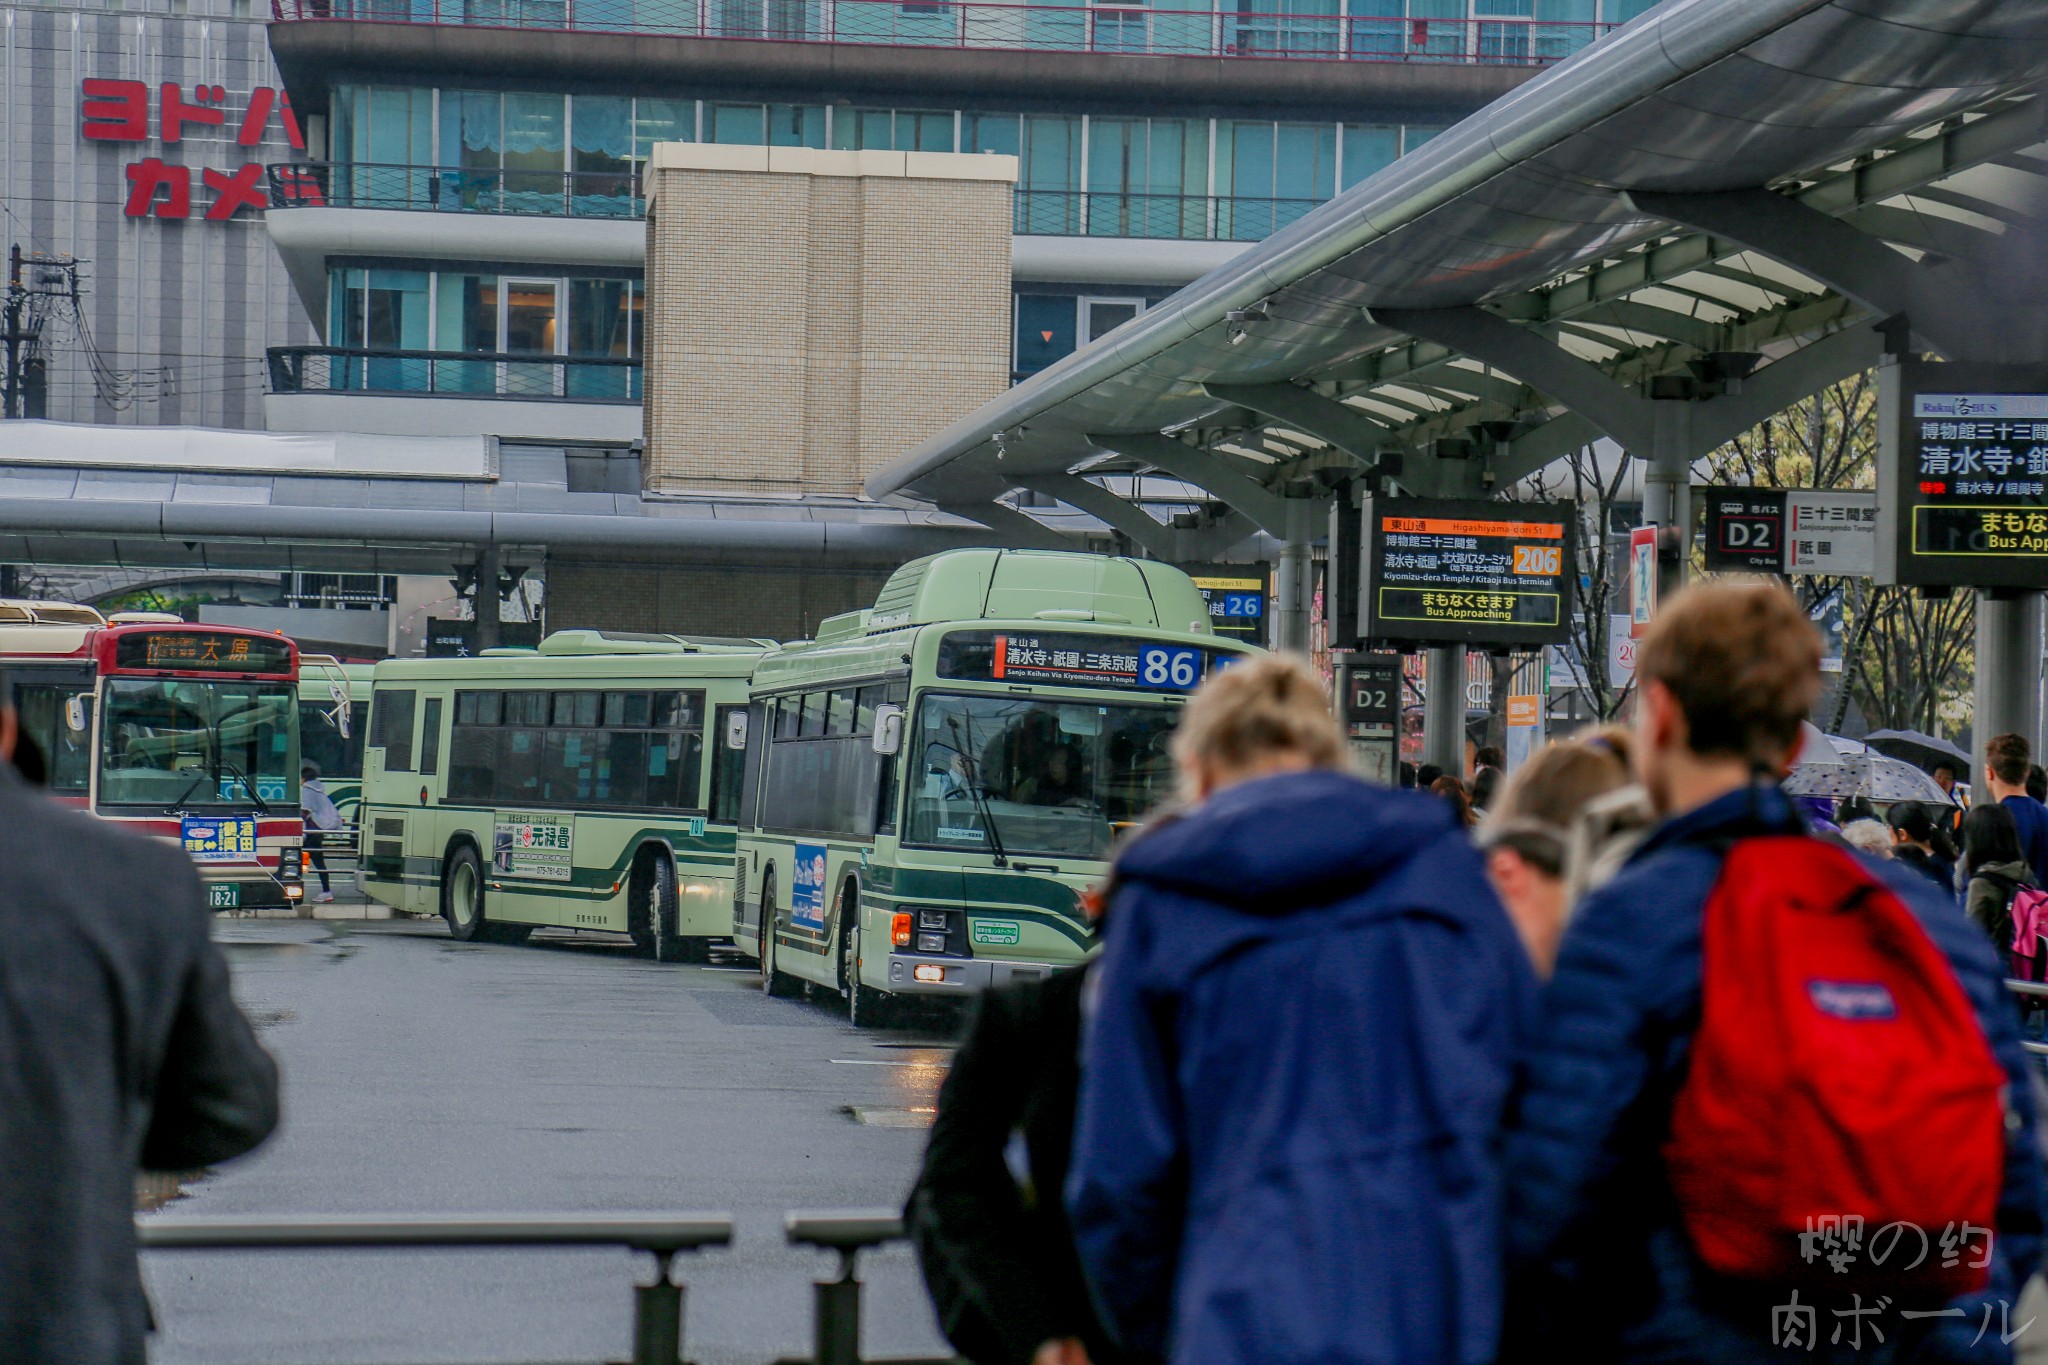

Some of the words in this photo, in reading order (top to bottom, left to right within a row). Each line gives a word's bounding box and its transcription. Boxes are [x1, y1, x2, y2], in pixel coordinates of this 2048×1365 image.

[1751, 505, 1779, 514] 市バス
[1799, 506, 1876, 522] 三十三間堂
[1390, 519, 1427, 532] 東山通
[1453, 522, 1532, 534] Higashiyama-dori
[1853, 525, 1875, 533] Templ
[1727, 522, 1770, 547] D2
[1988, 535, 2018, 548] Bus
[1385, 534, 1478, 550] 博物館三十三間堂
[1517, 547, 1558, 573] 206
[1749, 557, 1764, 566] City
[1798, 557, 1815, 565] Gion
[1195, 580, 1234, 588] ishioji-dori
[1383, 572, 1441, 583] Kiyomizu-dera
[1441, 574, 1470, 584] Temple
[1475, 575, 1502, 586] Kitaoji
[1517, 577, 1552, 586] Terminal
[1200, 590, 1211, 599] 町
[1421, 592, 1517, 609] まもなくきます
[1229, 597, 1258, 616] 26
[1426, 607, 1444, 617] Bus
[1446, 608, 1512, 621] Approaching
[1007, 637, 1039, 648] 東山通
[1144, 649, 1194, 686] 86
[1007, 668, 1026, 677] Sanjo
[1027, 670, 1050, 678] Keihan
[1051, 671, 1062, 679] Via
[1063, 672, 1111, 682] Kiyomizu-dera
[1112, 676, 1136, 684] Temple
[1356, 690, 1387, 708] D2
